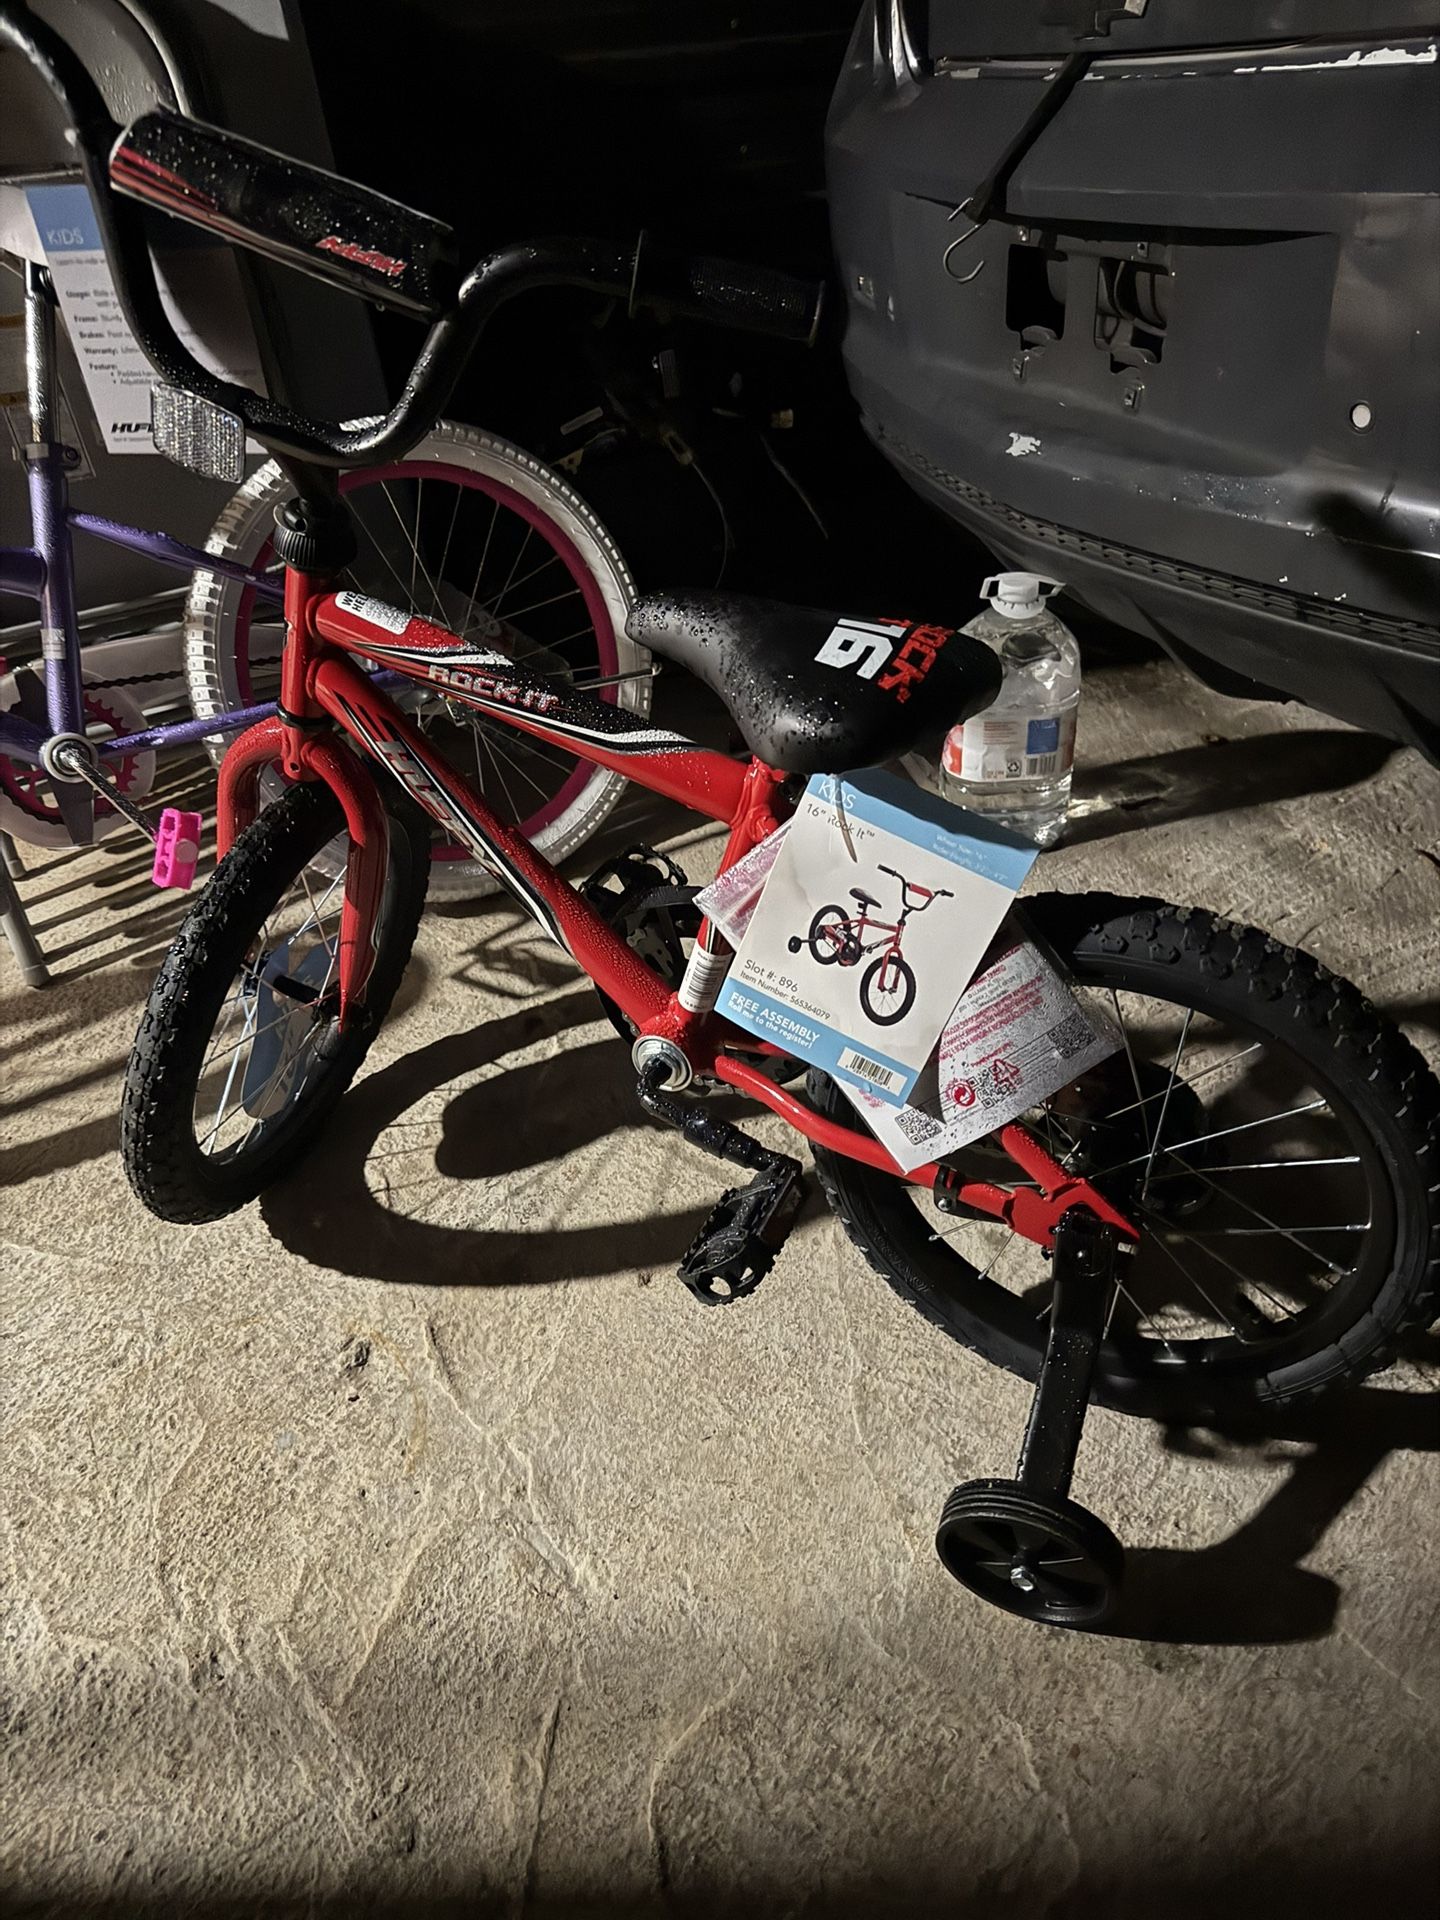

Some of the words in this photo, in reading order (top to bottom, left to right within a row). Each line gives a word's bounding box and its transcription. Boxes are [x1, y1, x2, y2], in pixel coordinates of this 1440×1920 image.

[47, 230, 84, 245] KIDS
[814, 618, 908, 680] 16
[428, 664, 523, 704] ROCK
[817, 780, 857, 809] KIDS
[806, 803, 827, 817] 16"
[827, 814, 855, 834] Rock
[744, 959, 766, 976] Slot
[766, 970, 777, 982] #:
[778, 976, 798, 993] 896
[740, 970, 757, 983] Item
[757, 979, 788, 998] Number:
[790, 995, 831, 1020] 565364079
[727, 999, 742, 1014] Roll
[742, 1010, 754, 1019] me
[755, 1015, 764, 1025] to
[765, 1021, 778, 1032] the
[730, 992, 760, 1013] FREE
[760, 1008, 820, 1042] ASSEMBLY
